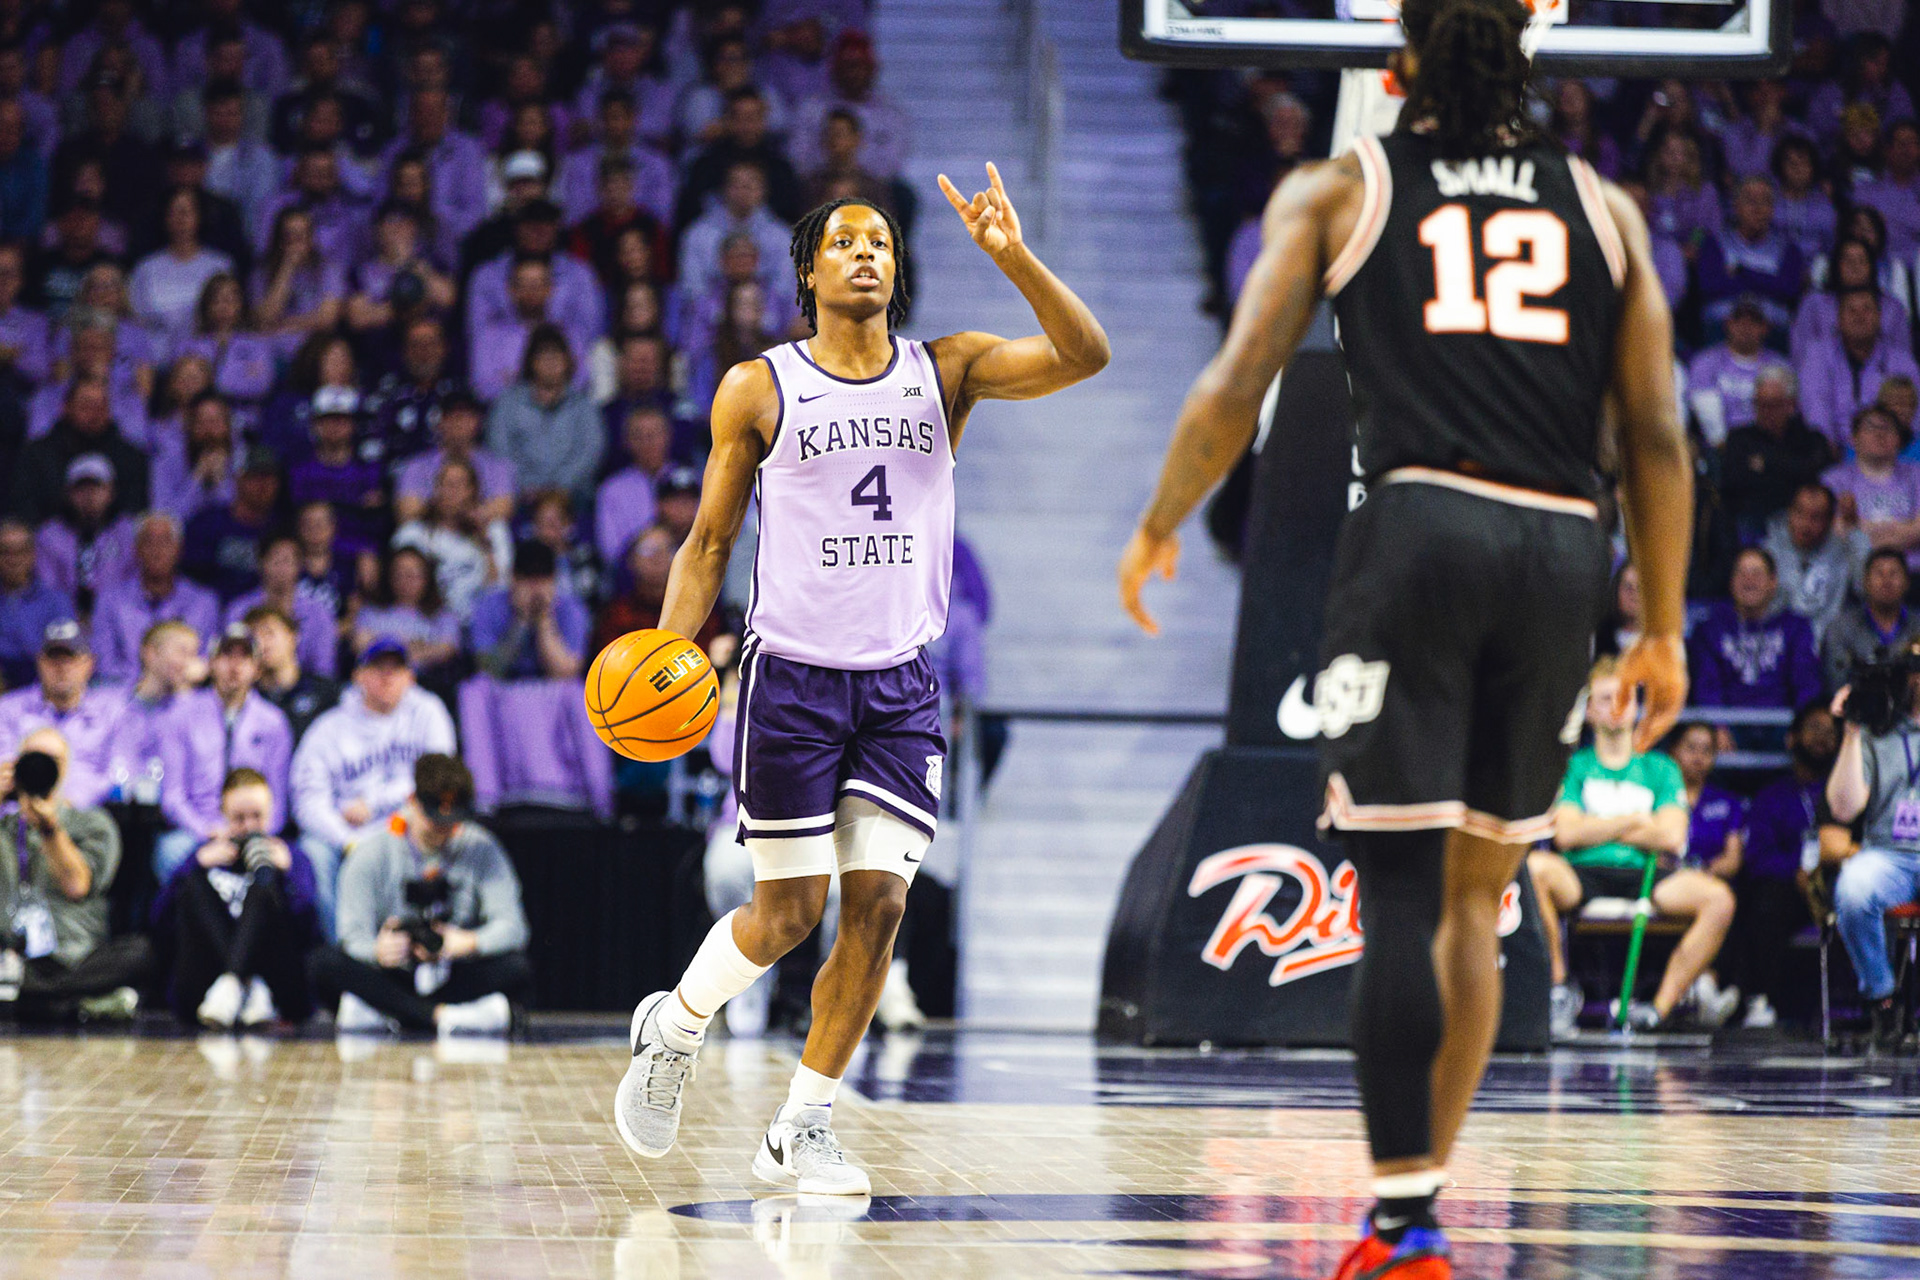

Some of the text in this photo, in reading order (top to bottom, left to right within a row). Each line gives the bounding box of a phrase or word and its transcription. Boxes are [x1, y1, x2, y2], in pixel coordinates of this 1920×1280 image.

[1418, 203, 1570, 346] 12
[901, 385, 924, 398] XII
[797, 416, 935, 463] KANSAS
[850, 464, 893, 521] 4
[820, 534, 914, 568] STATE
[647, 648, 704, 694] ELITE
